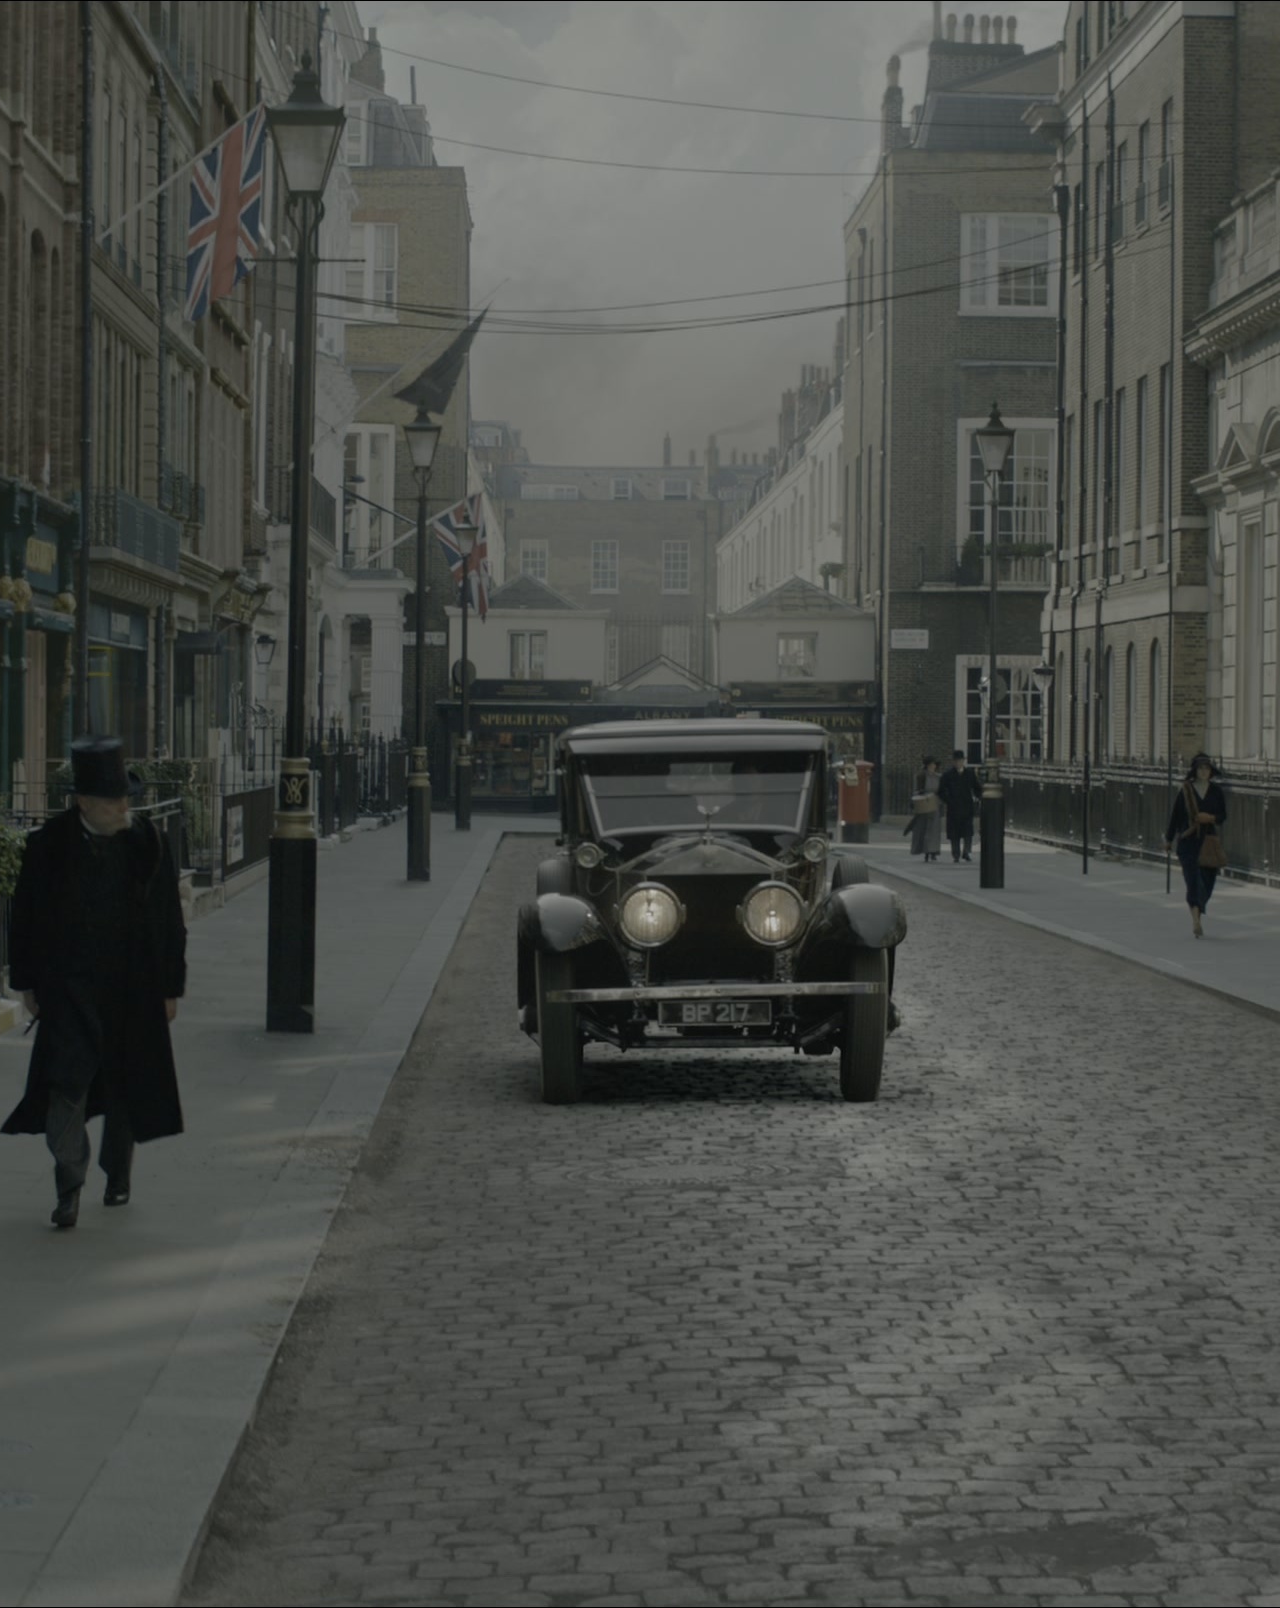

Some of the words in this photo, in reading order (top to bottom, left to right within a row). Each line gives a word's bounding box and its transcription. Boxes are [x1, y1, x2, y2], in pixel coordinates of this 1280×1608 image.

[480, 713, 534, 726] SPEIGHT
[537, 713, 569, 726] PENS
[831, 713, 865, 727] PENS
[682, 1004, 712, 1022] BP
[716, 1004, 749, 1022] 217
